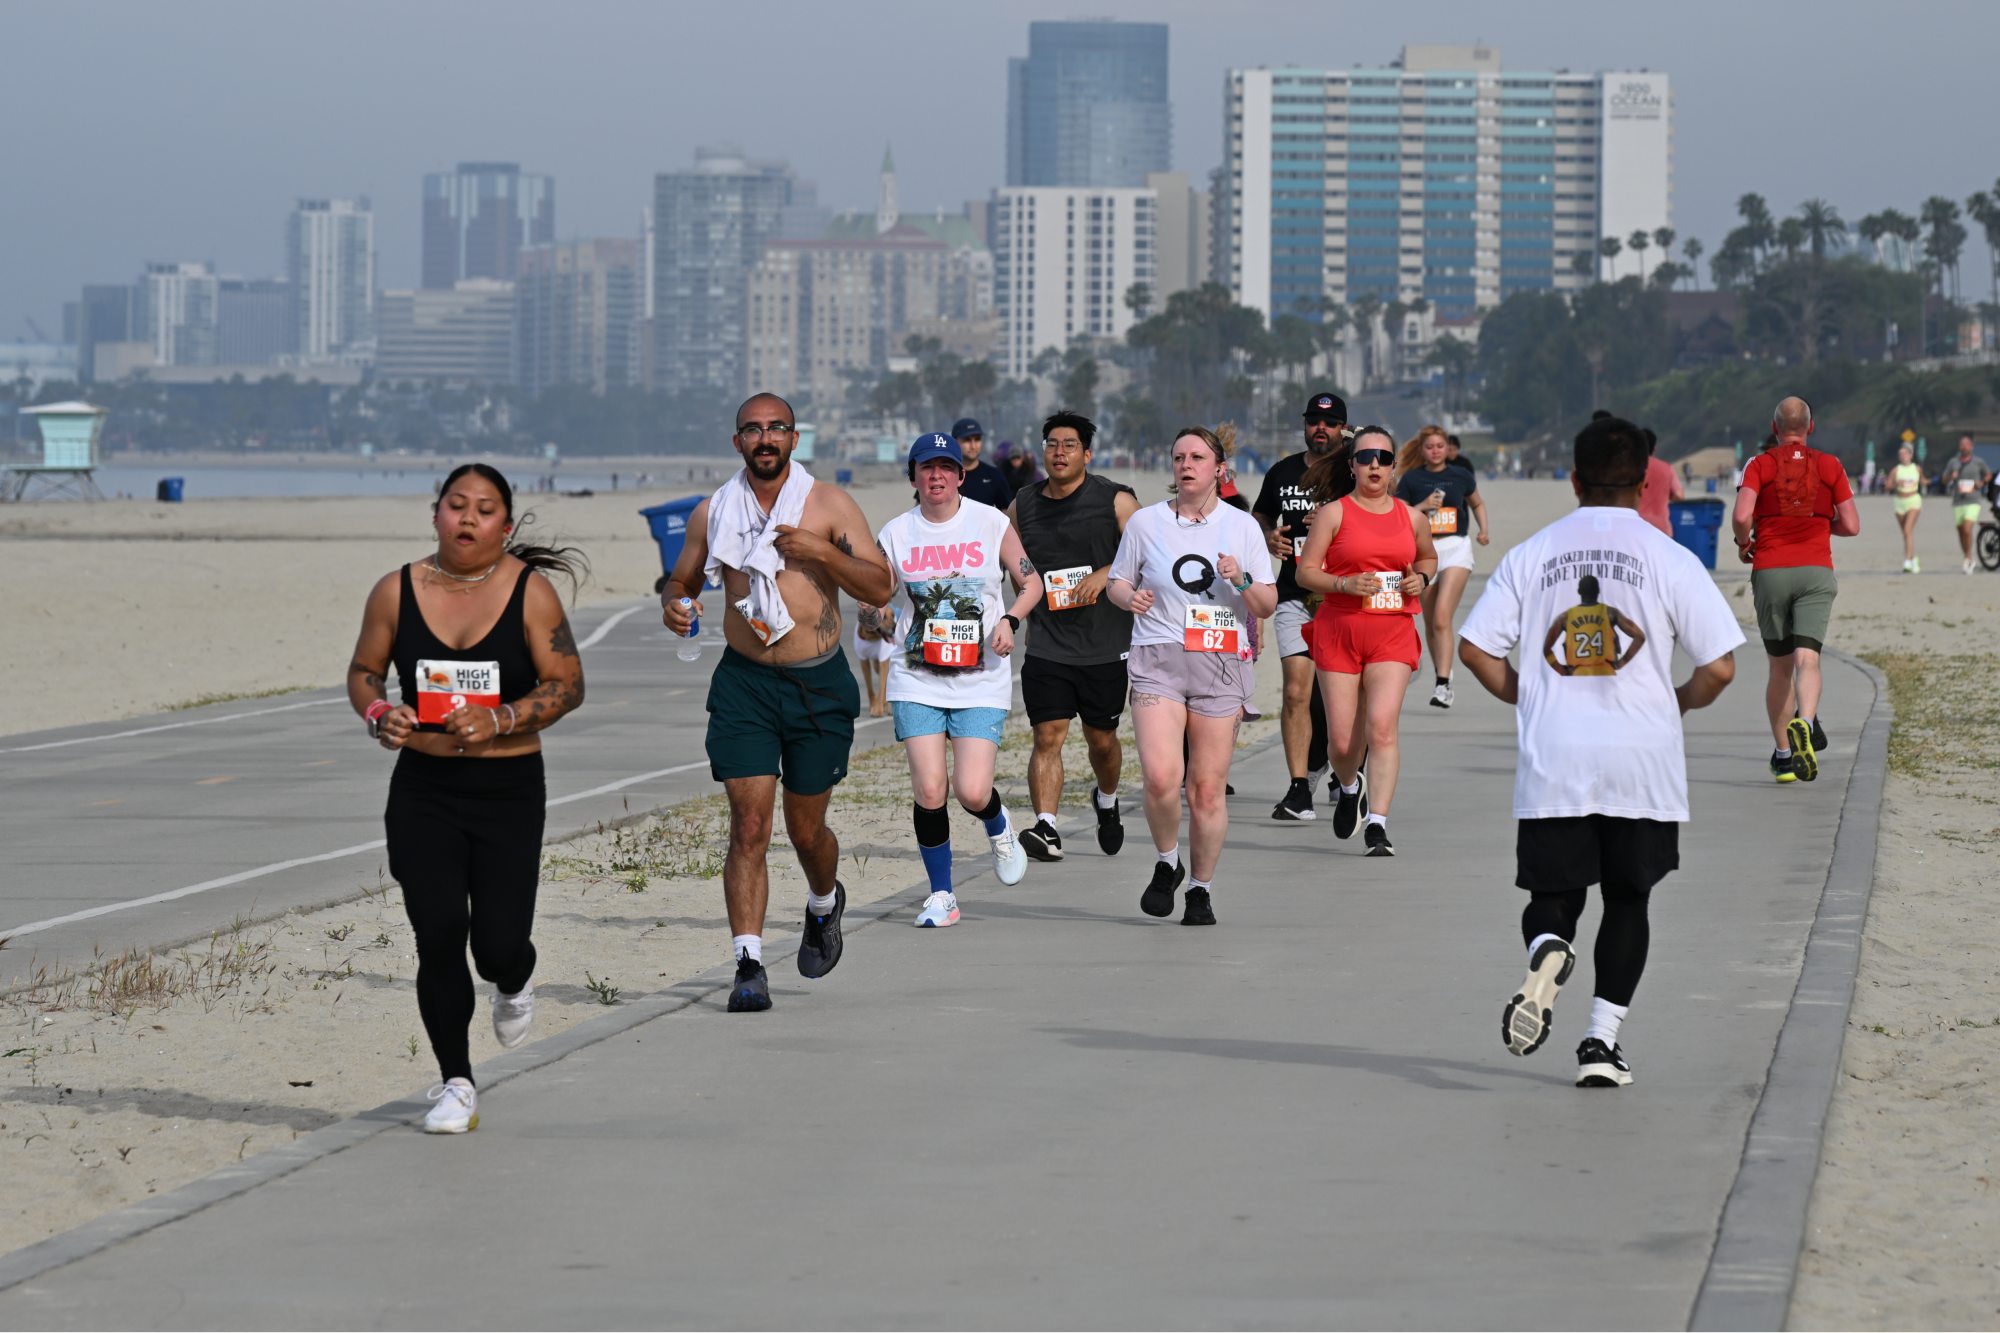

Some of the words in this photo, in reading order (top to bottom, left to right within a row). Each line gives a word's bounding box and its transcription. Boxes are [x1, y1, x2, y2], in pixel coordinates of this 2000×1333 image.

[1610, 94, 1661, 107] OCEAN
[934, 434, 947, 448] LA
[1282, 499, 1321, 511] ARM
[901, 541, 985, 573] JAWS
[1542, 557, 1557, 574] YOU
[1560, 551, 1584, 565] ASKED
[1585, 550, 1602, 561] FOR
[1603, 550, 1615, 562] MY
[1616, 551, 1645, 575] HUSTLE
[1067, 571, 1088, 579] HIGH
[1547, 565, 1570, 587] GAVE
[1572, 563, 1594, 579] YOU
[1596, 563, 1610, 579] MY
[1612, 565, 1645, 590] HEART
[1053, 590, 1089, 608] 16
[1370, 593, 1403, 609] 1635
[1214, 611, 1235, 619] HIGH
[1571, 614, 1605, 629] BRYANT
[1214, 619, 1235, 627] TIDE
[1203, 630, 1225, 649] 62
[1574, 630, 1604, 658] 24
[941, 644, 961, 663] 61
[456, 669, 490, 679] HIGH
[457, 680, 491, 690] TIDE
